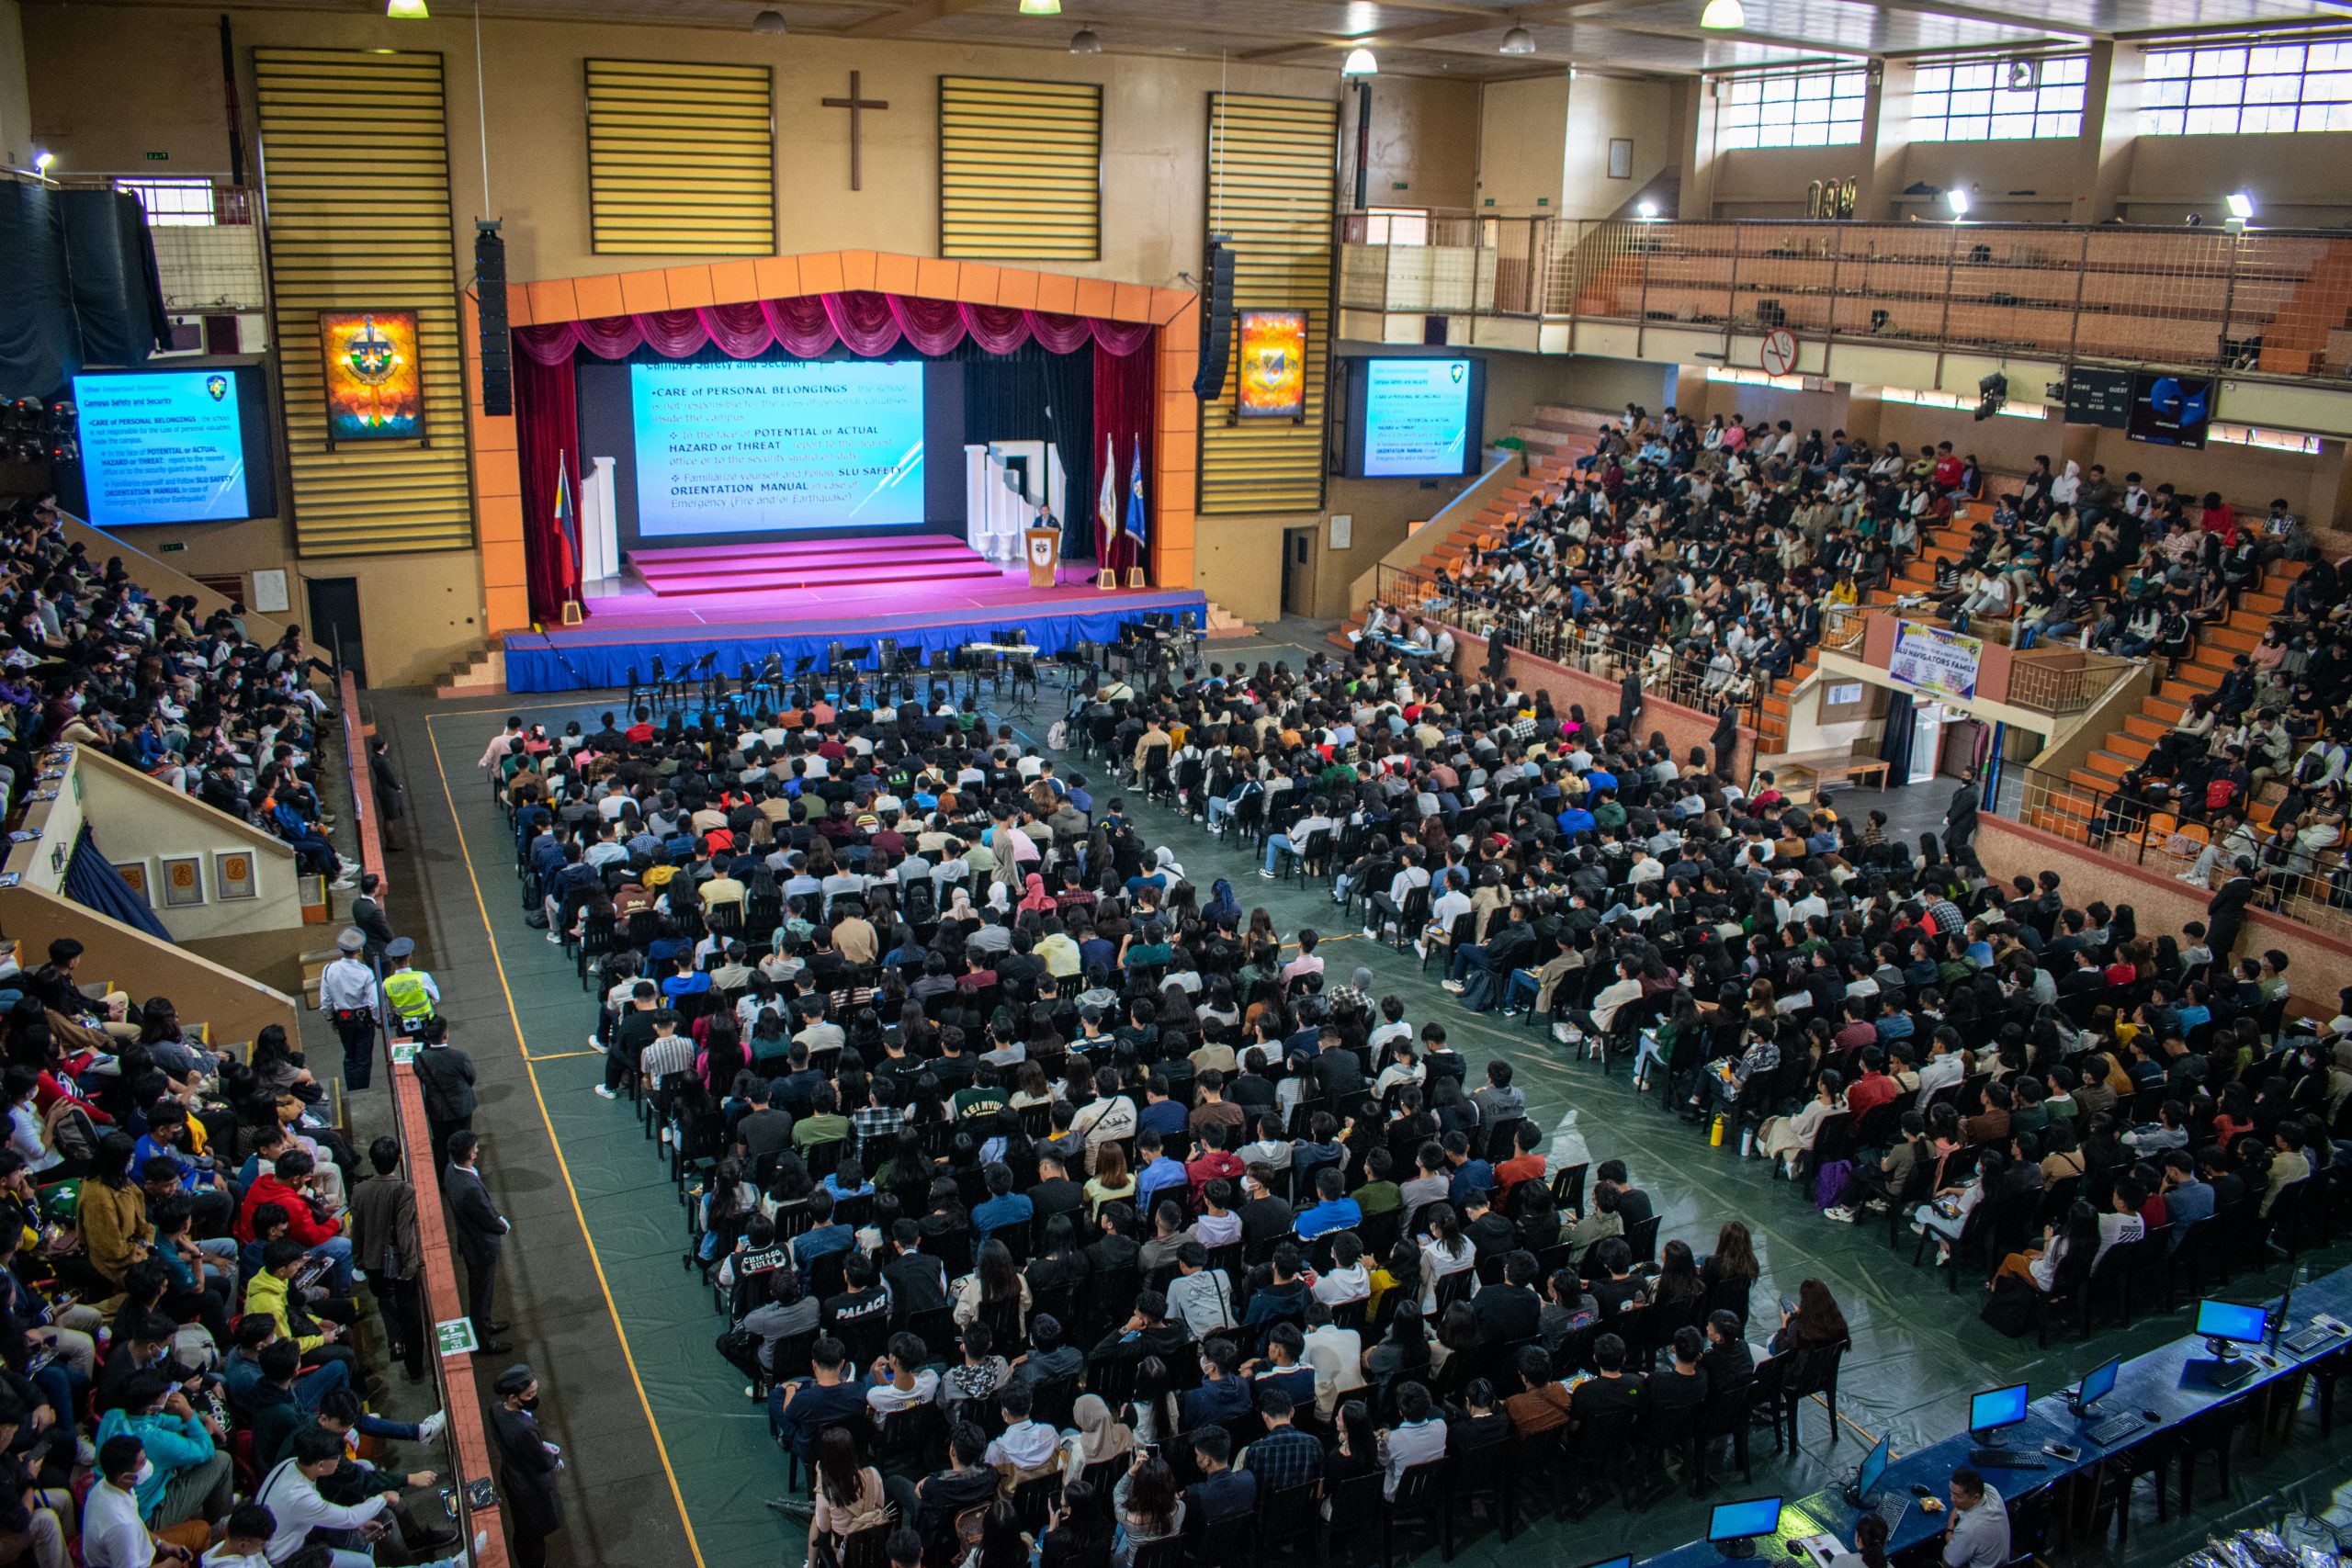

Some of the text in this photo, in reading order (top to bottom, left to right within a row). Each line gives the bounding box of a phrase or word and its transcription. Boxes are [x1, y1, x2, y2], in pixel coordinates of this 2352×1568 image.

[657, 388, 687, 396] CARE
[692, 388, 703, 396] of
[707, 386, 767, 395] PERSONAL
[773, 385, 848, 394] BELONGINGS
[755, 428, 818, 437] POTENTIAL
[837, 426, 880, 435] ACTUAL
[669, 443, 718, 452] HAZARD
[736, 441, 781, 451] THREAT
[838, 468, 859, 476] SLU
[105, 489, 152, 497] ORIENTATION
[671, 484, 753, 496] ORIENTATION
[761, 482, 808, 491] MANUAL
[1908, 650, 1950, 666] NAVIGATORS
[1951, 661, 1975, 673] FAMILY
[743, 1249, 781, 1264] CHICAGO
[750, 1257, 777, 1270] BULLS
[836, 1293, 886, 1320] PALACE
